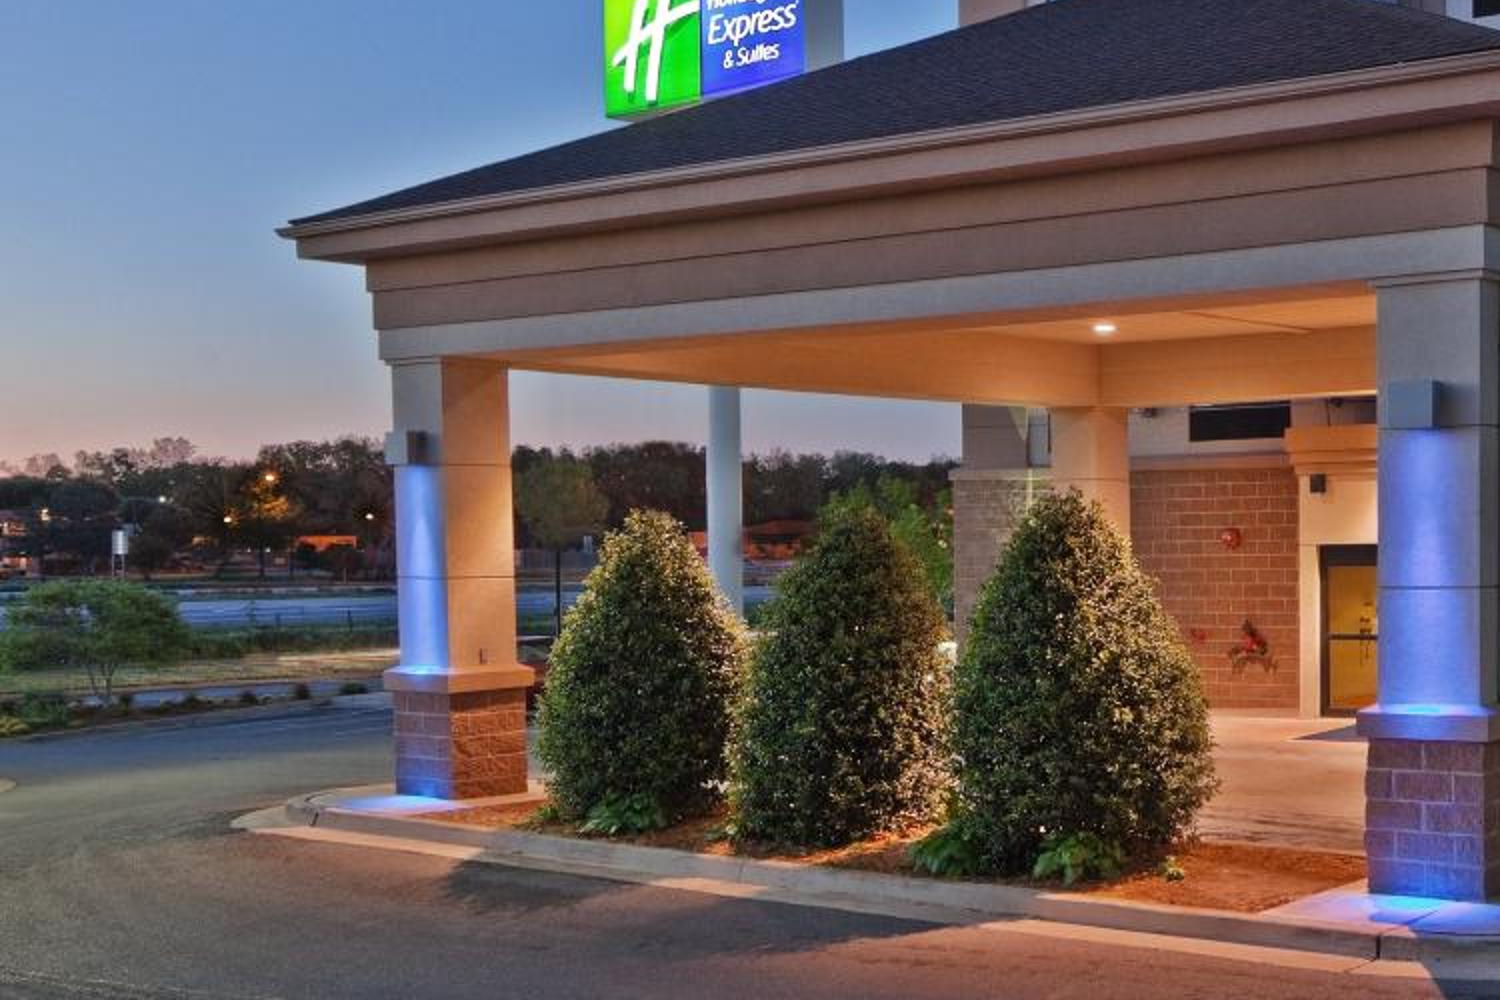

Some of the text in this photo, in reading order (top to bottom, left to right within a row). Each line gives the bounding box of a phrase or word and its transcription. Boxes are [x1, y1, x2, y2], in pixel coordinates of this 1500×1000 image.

[707, 2, 797, 47] Express
[723, 43, 780, 69] & Suites
